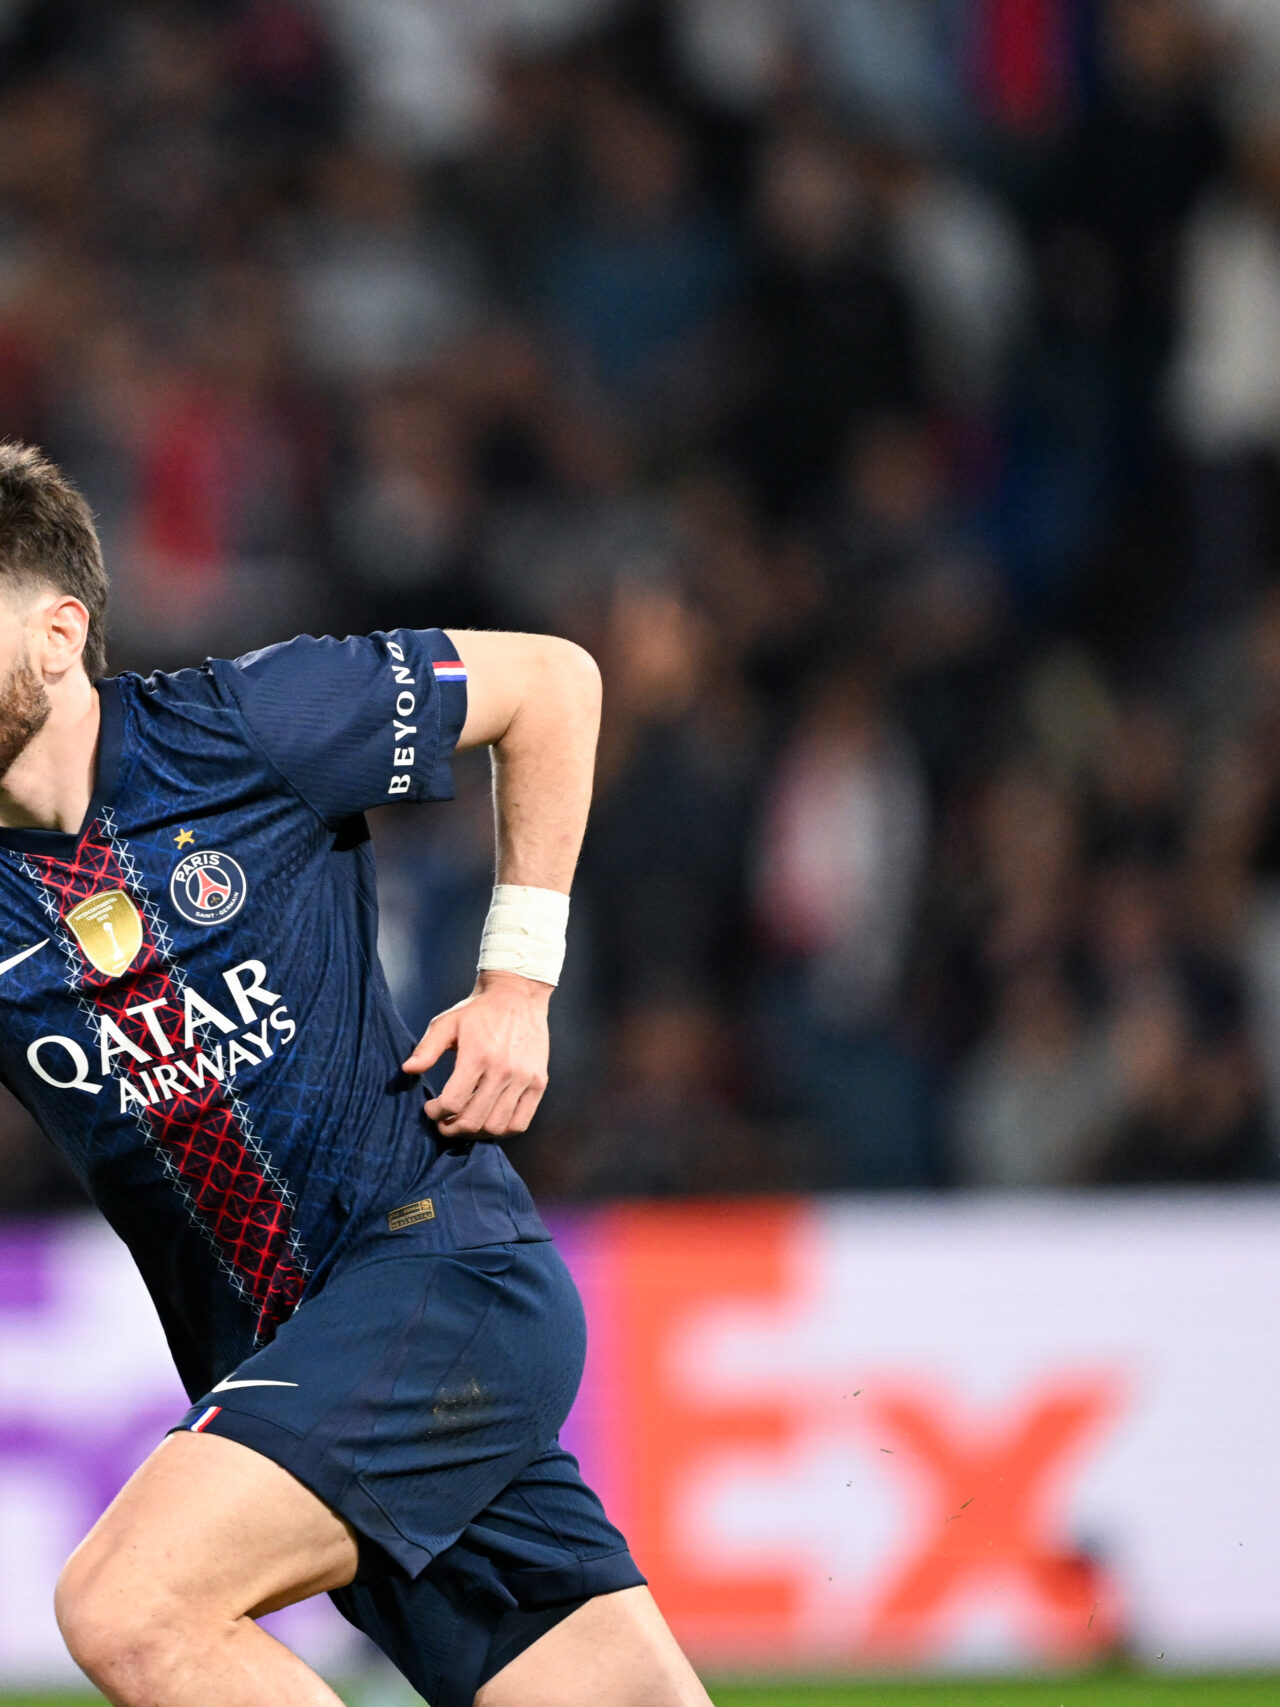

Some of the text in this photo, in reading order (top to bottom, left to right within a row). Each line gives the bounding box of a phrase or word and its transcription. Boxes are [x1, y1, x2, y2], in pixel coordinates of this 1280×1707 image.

[386, 641, 418, 794] BEYOND
[175, 853, 221, 883] PARIS
[26, 959, 282, 1095] QATAR
[120, 1005, 297, 1114] AIRWAYS
